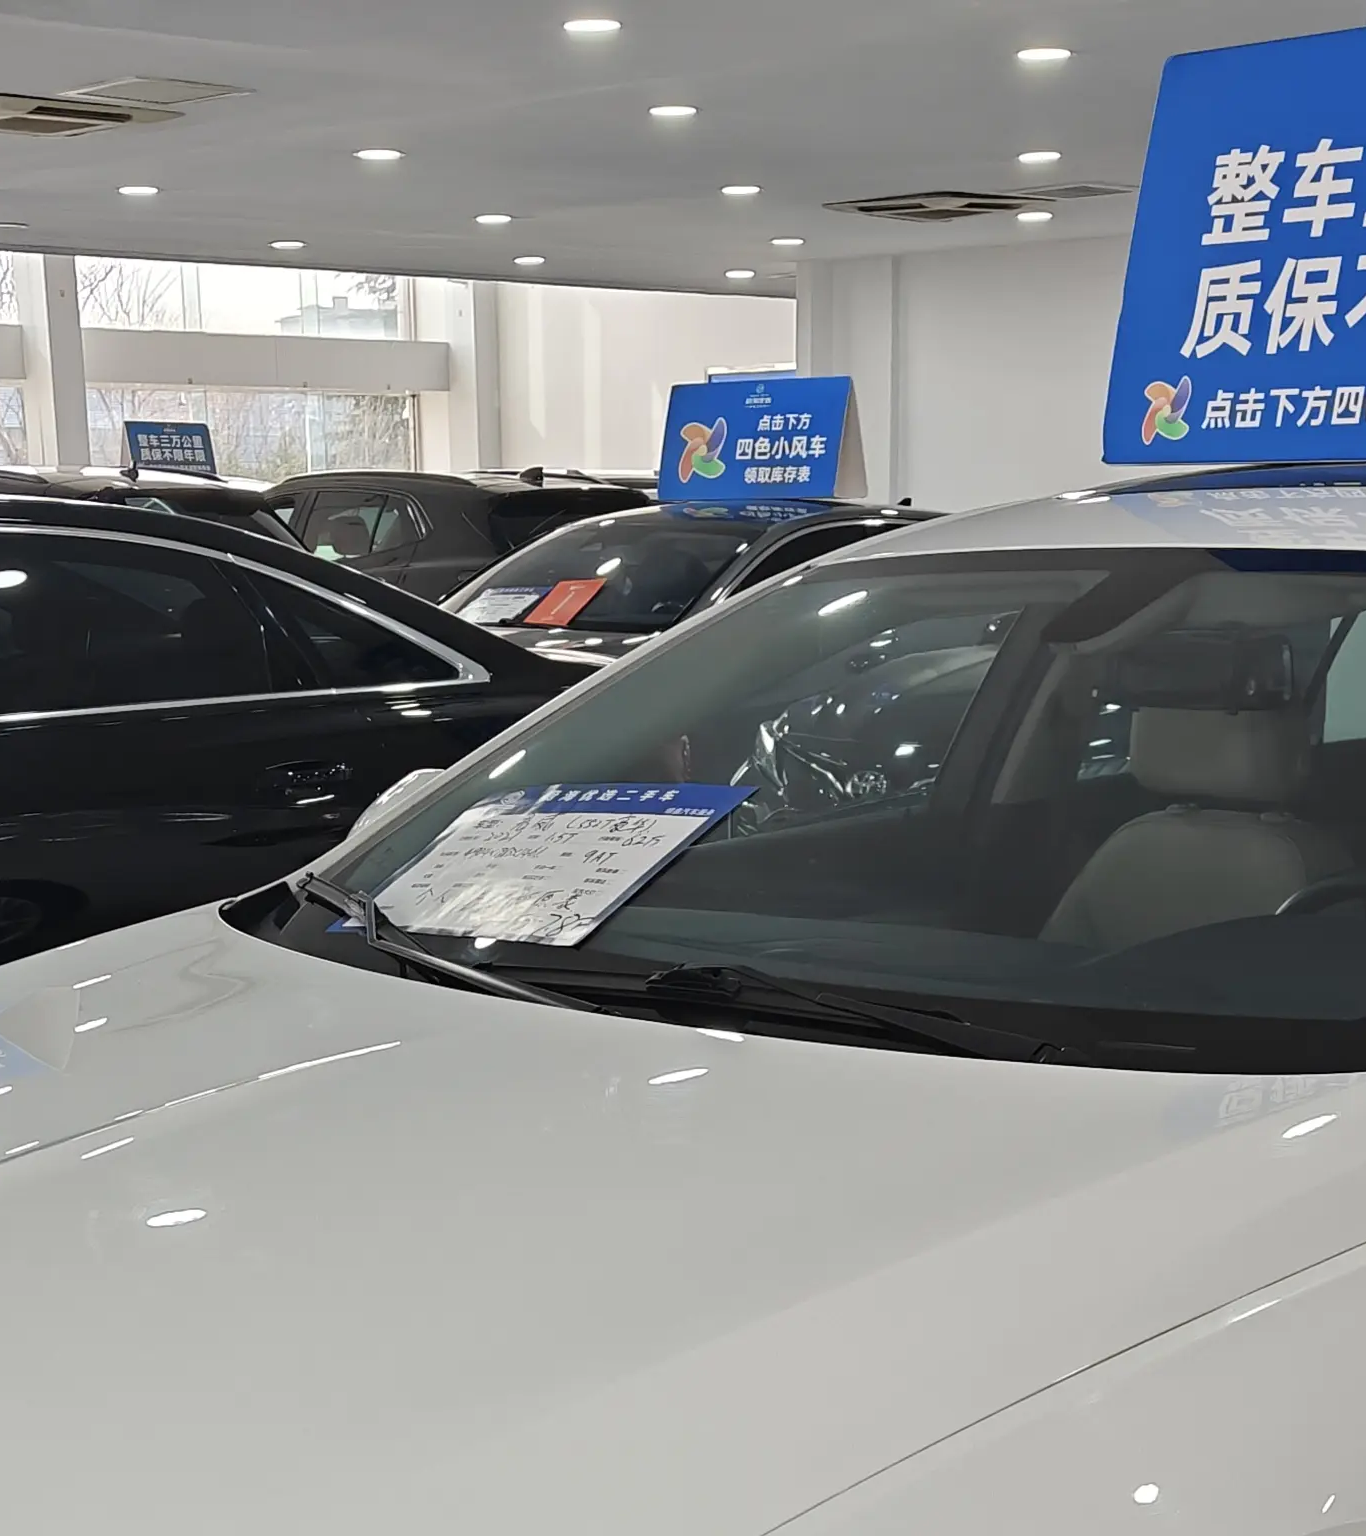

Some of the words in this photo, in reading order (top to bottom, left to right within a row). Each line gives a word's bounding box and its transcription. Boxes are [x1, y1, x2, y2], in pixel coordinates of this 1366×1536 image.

[757, 413, 813, 431] 点击下方
[137, 433, 204, 448] 整车三万公里
[735, 434, 828, 460] 四色小风车
[140, 448, 207, 462] 质保不限年限
[743, 465, 812, 484] 领取库存表
